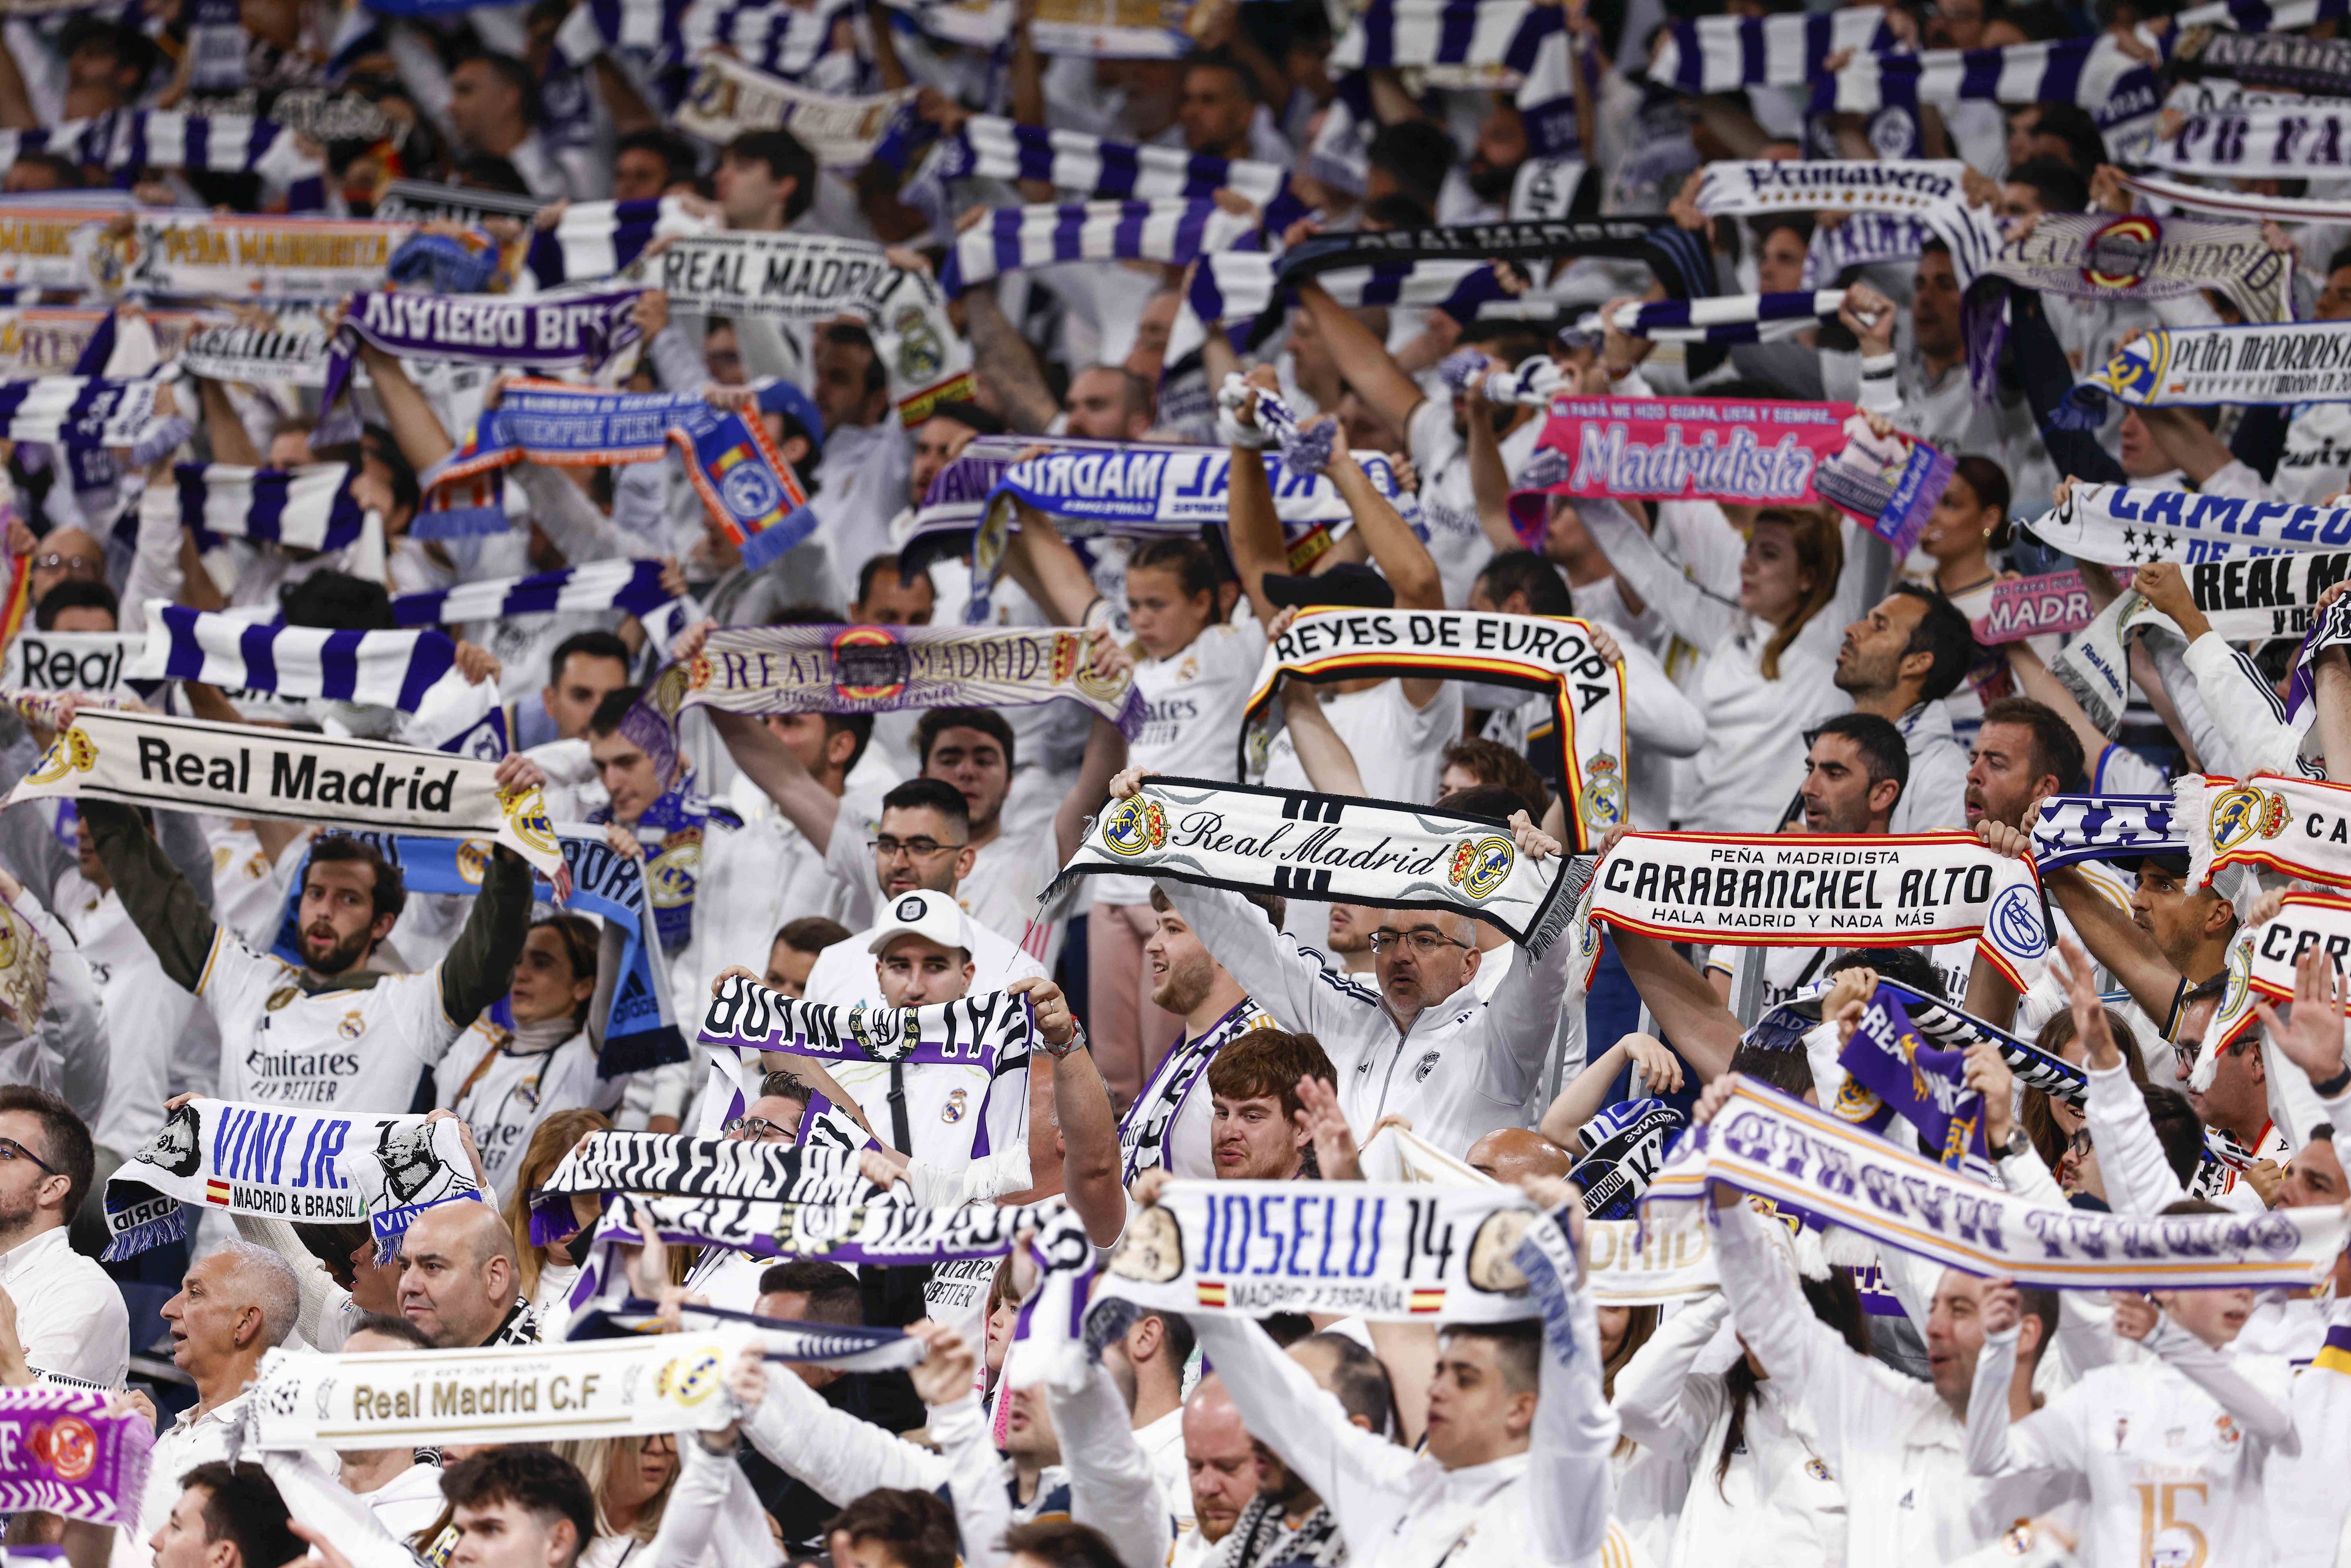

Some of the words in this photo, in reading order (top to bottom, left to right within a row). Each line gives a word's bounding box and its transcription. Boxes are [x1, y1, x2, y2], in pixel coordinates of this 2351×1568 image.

[664, 249, 748, 294] REAL
[761, 253, 905, 302] MADRID
[2171, 333, 2233, 372] PEÑA
[1722, 407, 1757, 423] LISTA
[1569, 421, 1816, 501] Madridista
[2192, 554, 2297, 611] REAL
[2306, 552, 2351, 605] M
[1987, 589, 2094, 635] MADR
[2271, 609, 2286, 635] y
[21, 638, 124, 690] Real
[723, 651, 830, 691] REAL
[911, 636, 1043, 683] MADRID
[1275, 615, 1398, 662] REYES
[1410, 615, 1461, 648] DE
[1475, 618, 1612, 715] EUROPA
[2080, 641, 2104, 670] Real
[137, 735, 250, 795] Real
[270, 751, 459, 813] Madrid
[1171, 810, 1295, 859] Real
[1280, 825, 1452, 876] Madrid
[1711, 848, 1765, 865] PEÑA
[1776, 850, 1901, 866] MADRIDISTA
[1603, 858, 1883, 910] CARABANCHEL
[1897, 864, 1994, 909] ALTO
[1651, 907, 1706, 925] HALA
[1718, 911, 1797, 928] MADRID
[1808, 914, 1821, 928] Y
[1830, 914, 1884, 929] NADA
[1895, 909, 1936, 926] MÁS
[247, 1048, 360, 1077] Emirates
[250, 1080, 279, 1100] FLY
[279, 1080, 338, 1103] BETTER
[213, 1106, 297, 1186] VINI
[290, 1118, 353, 1190] JR.
[541, 1131, 683, 1192] NORTH
[680, 1140, 792, 1199] FANS
[234, 1185, 287, 1214] MADRID
[292, 1195, 301, 1215] &
[305, 1195, 356, 1218] BRASIL
[1723, 1111, 2009, 1253] MADRID
[1195, 1194, 1386, 1279] JOSELU
[1402, 1198, 1455, 1281] 14
[926, 1281, 977, 1308] BETTER
[353, 1382, 421, 1420] Real
[431, 1376, 539, 1417] Madrid
[549, 1373, 601, 1410] C.F
[2128, 1482, 2209, 1568] 15
